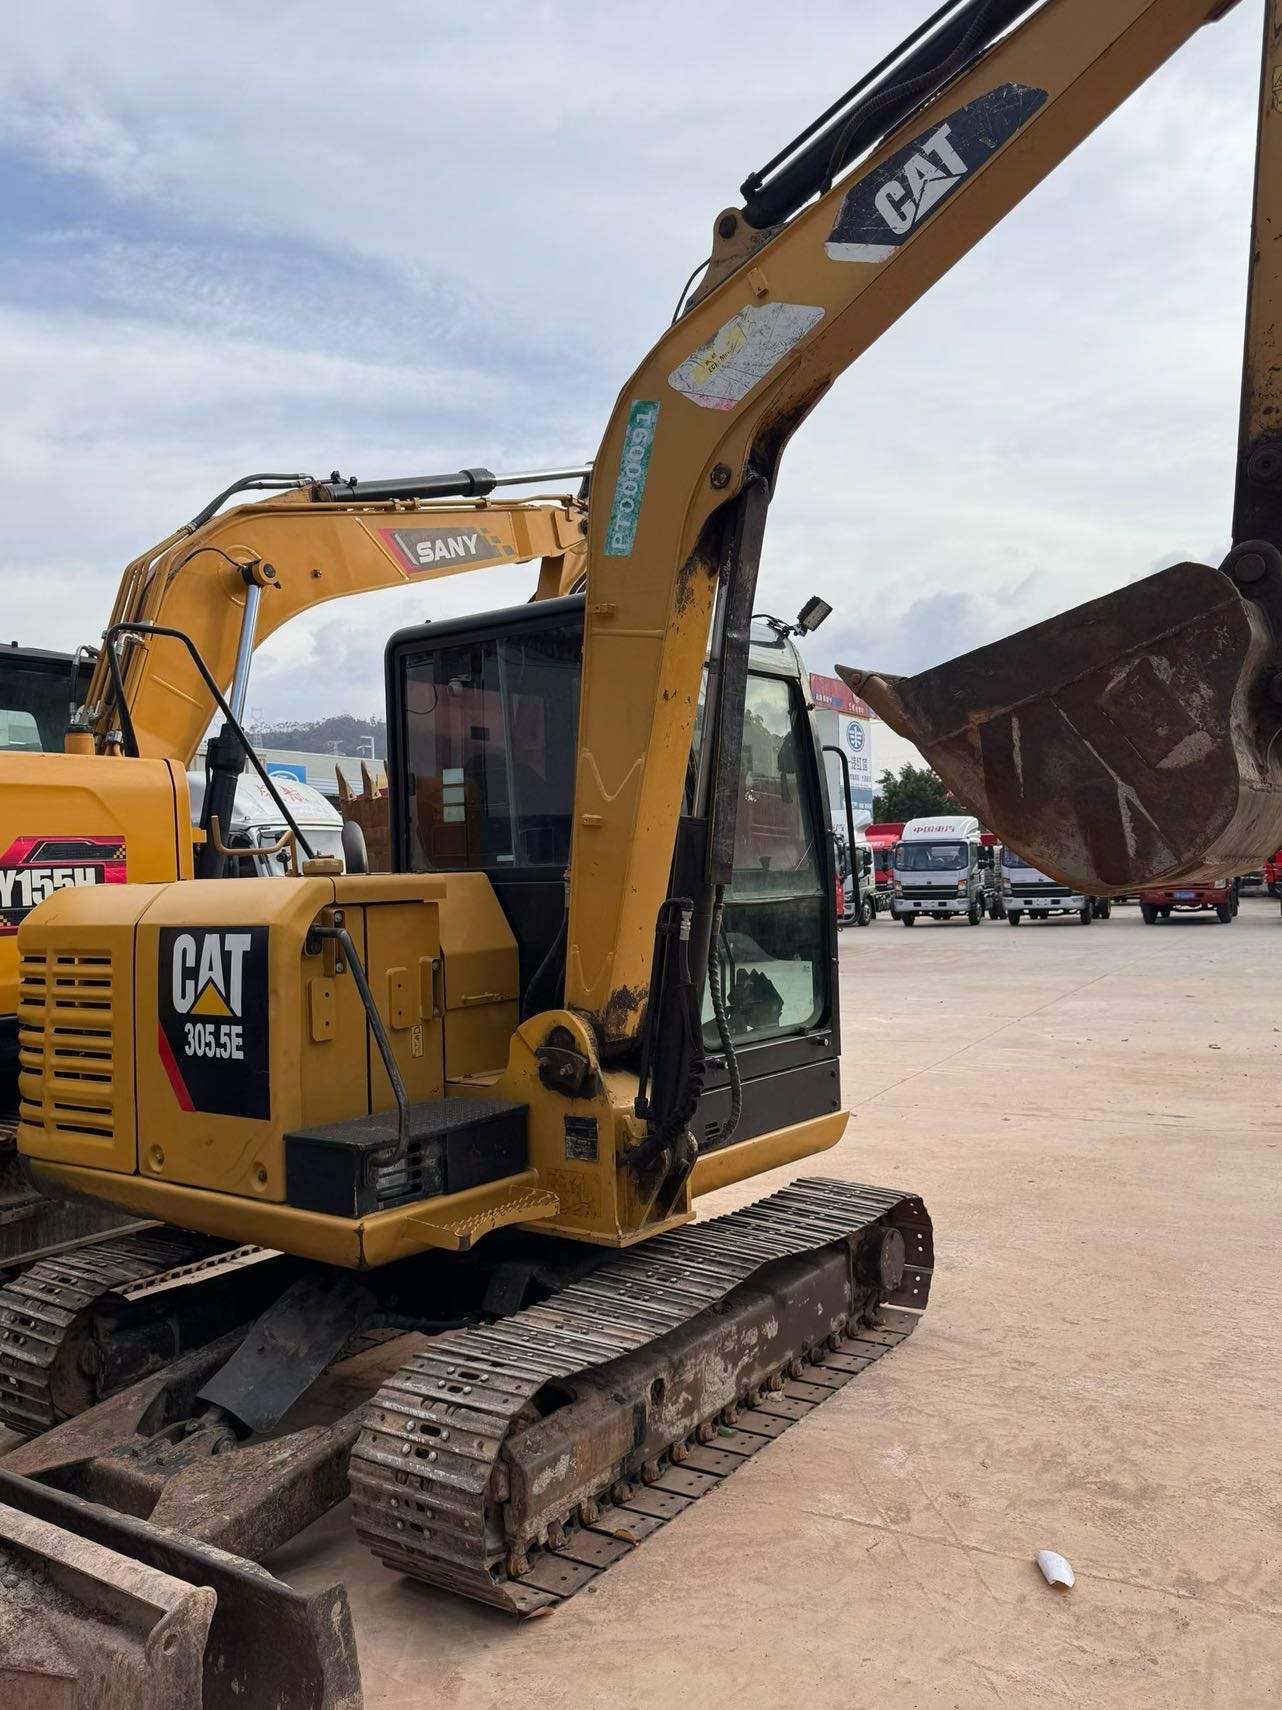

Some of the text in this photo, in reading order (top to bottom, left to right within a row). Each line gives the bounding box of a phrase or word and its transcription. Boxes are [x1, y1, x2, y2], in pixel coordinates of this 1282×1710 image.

[874, 123, 969, 235] CAT
[416, 533, 478, 564] SANY
[172, 933, 251, 1018] CAT
[184, 1022, 245, 1060] 305.5E
